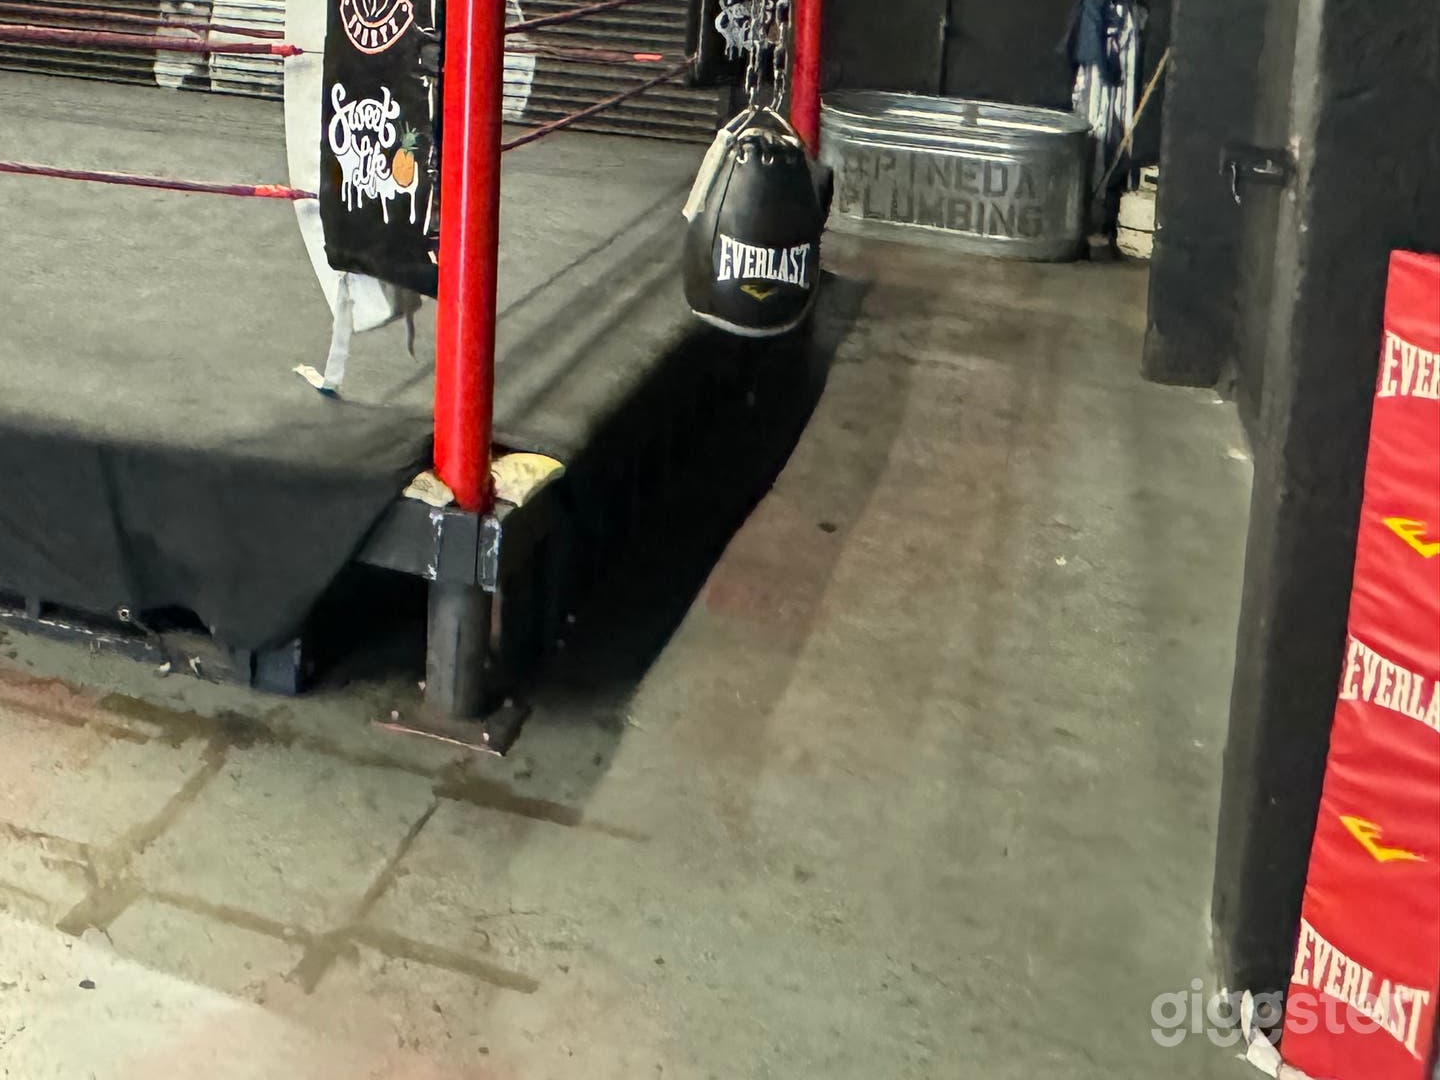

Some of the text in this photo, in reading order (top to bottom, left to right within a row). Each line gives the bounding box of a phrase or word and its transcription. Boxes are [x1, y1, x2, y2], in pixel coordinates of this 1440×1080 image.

[328, 82, 401, 156] Sweet
[351, 134, 391, 198] Life
[717, 233, 811, 289] EVERLAST
[1291, 916, 1430, 1061] EVERLAST
